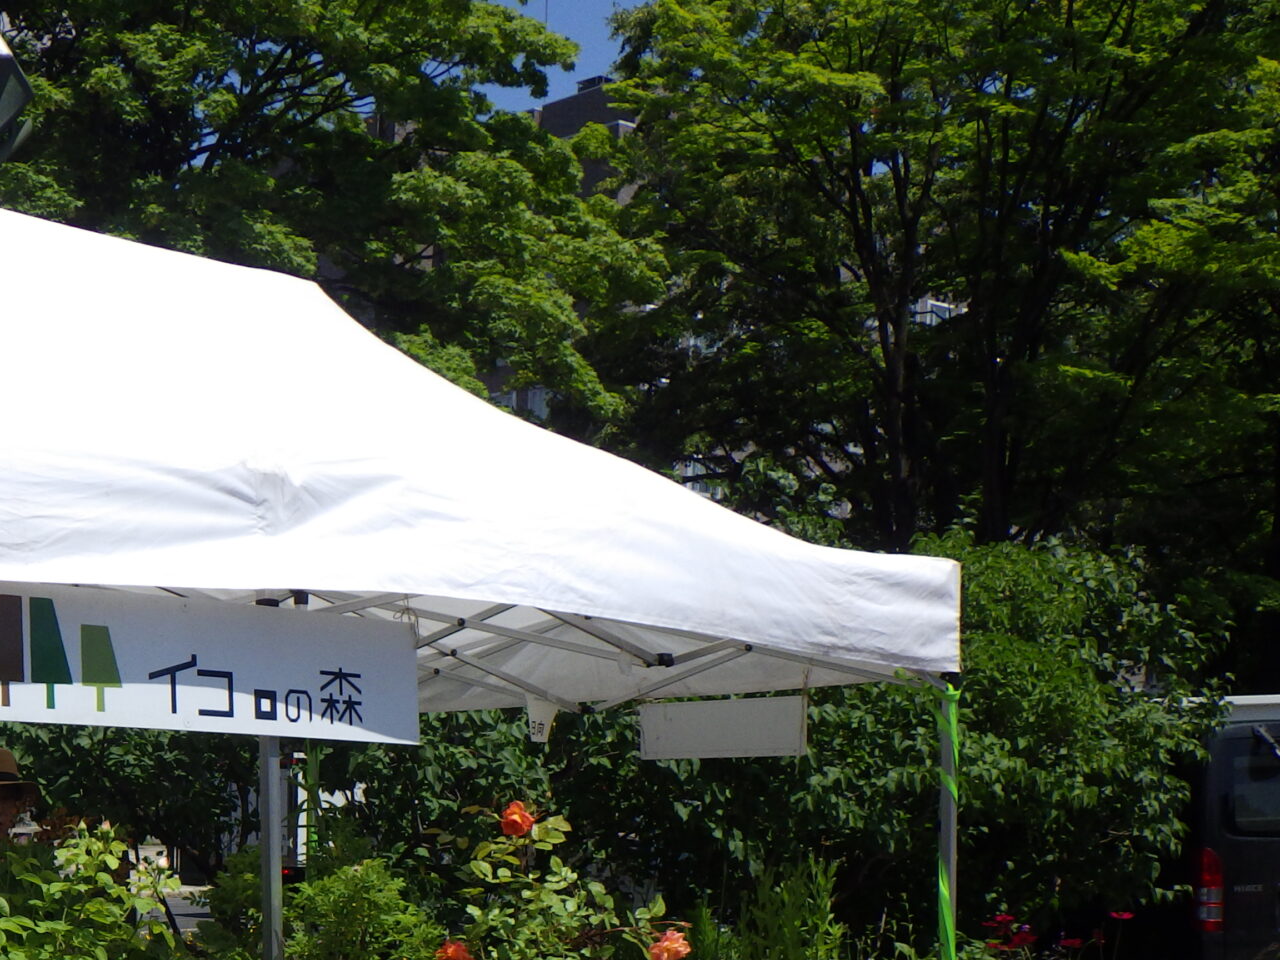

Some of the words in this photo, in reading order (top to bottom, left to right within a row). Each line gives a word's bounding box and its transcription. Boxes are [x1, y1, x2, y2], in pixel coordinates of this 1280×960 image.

[148, 653, 364, 726] イコロの森
